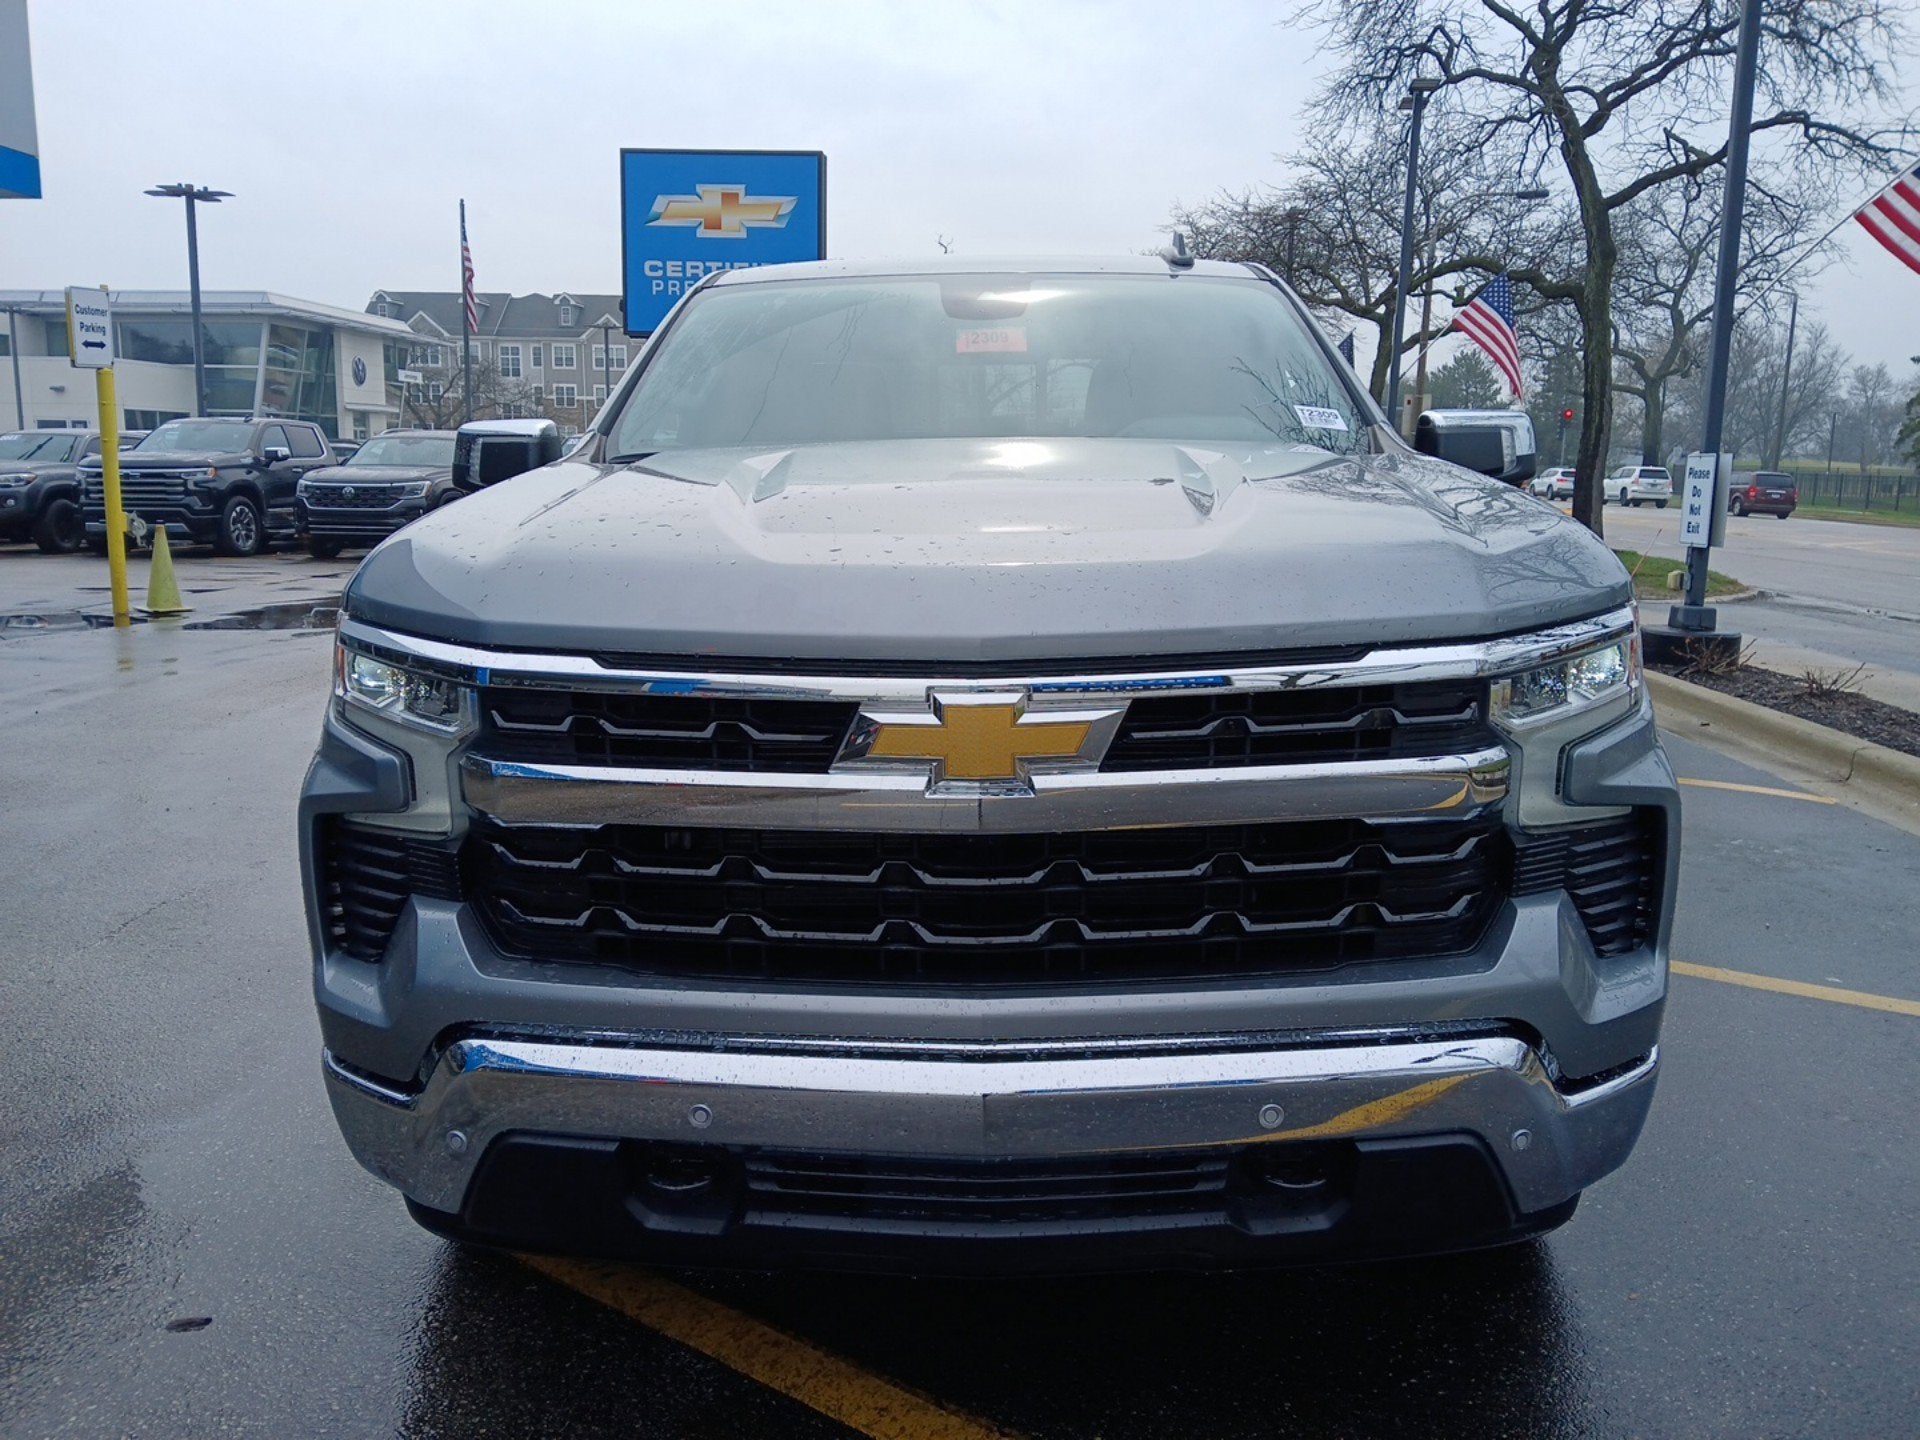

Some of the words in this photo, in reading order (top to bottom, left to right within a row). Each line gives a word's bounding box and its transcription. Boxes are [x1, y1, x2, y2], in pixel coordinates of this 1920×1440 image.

[75, 304, 108, 316] Customer
[80, 322, 106, 336] Parking
[1688, 467, 1710, 480] Please
[1692, 485, 1702, 498] Do
[1689, 503, 1701, 516] Not
[1687, 521, 1700, 534] Exit
